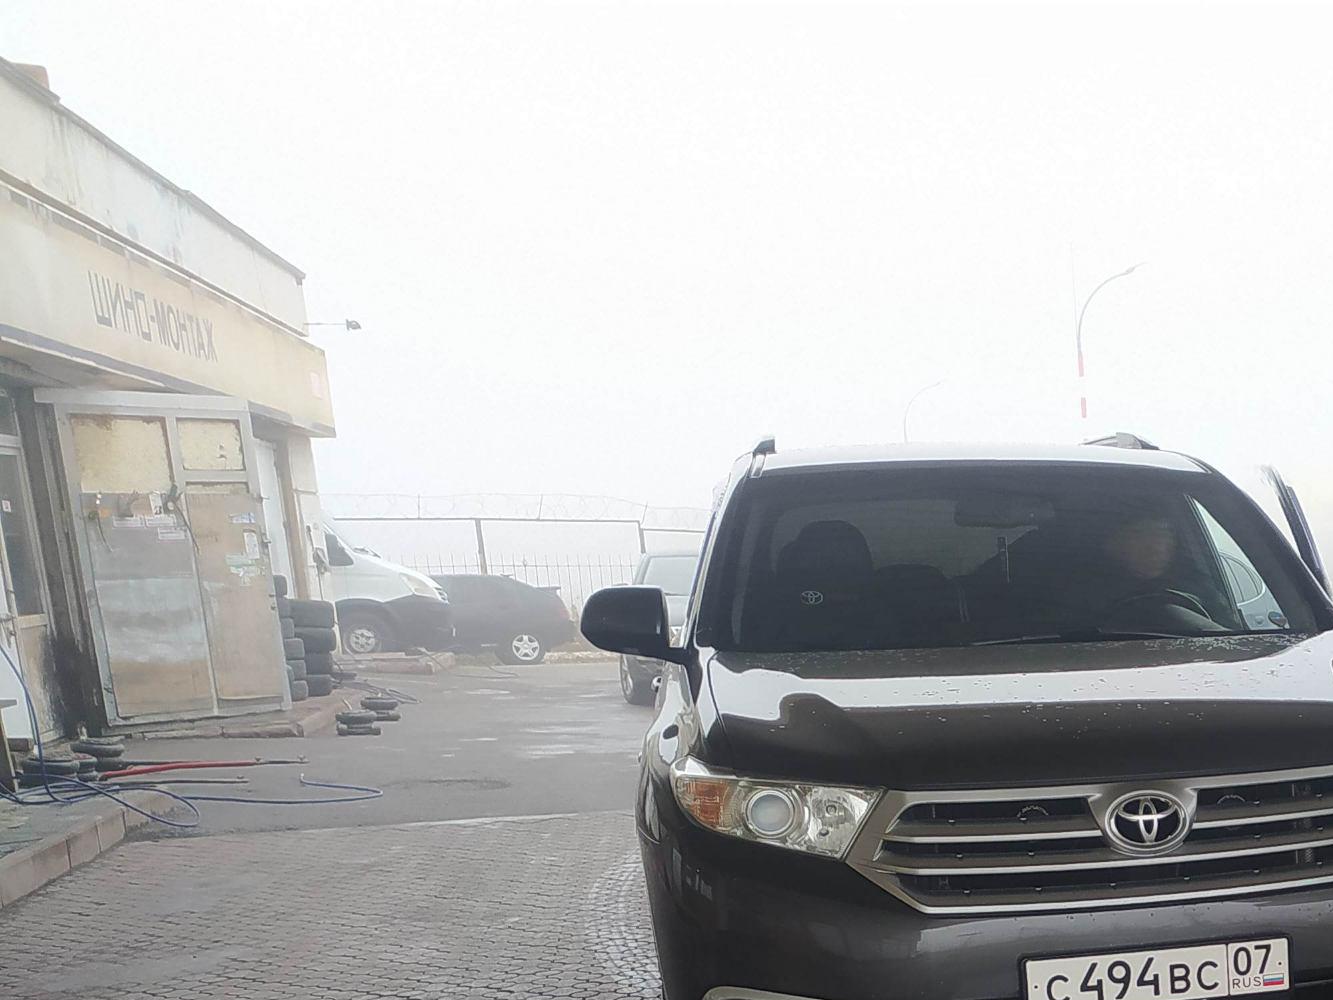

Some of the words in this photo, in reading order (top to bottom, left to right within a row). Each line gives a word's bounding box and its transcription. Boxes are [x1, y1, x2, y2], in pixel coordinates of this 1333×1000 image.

[87, 270, 218, 363] ШИНО-МОНТАЖ
[1233, 944, 1272, 976] 07
[1232, 976, 1262, 989] RUS
